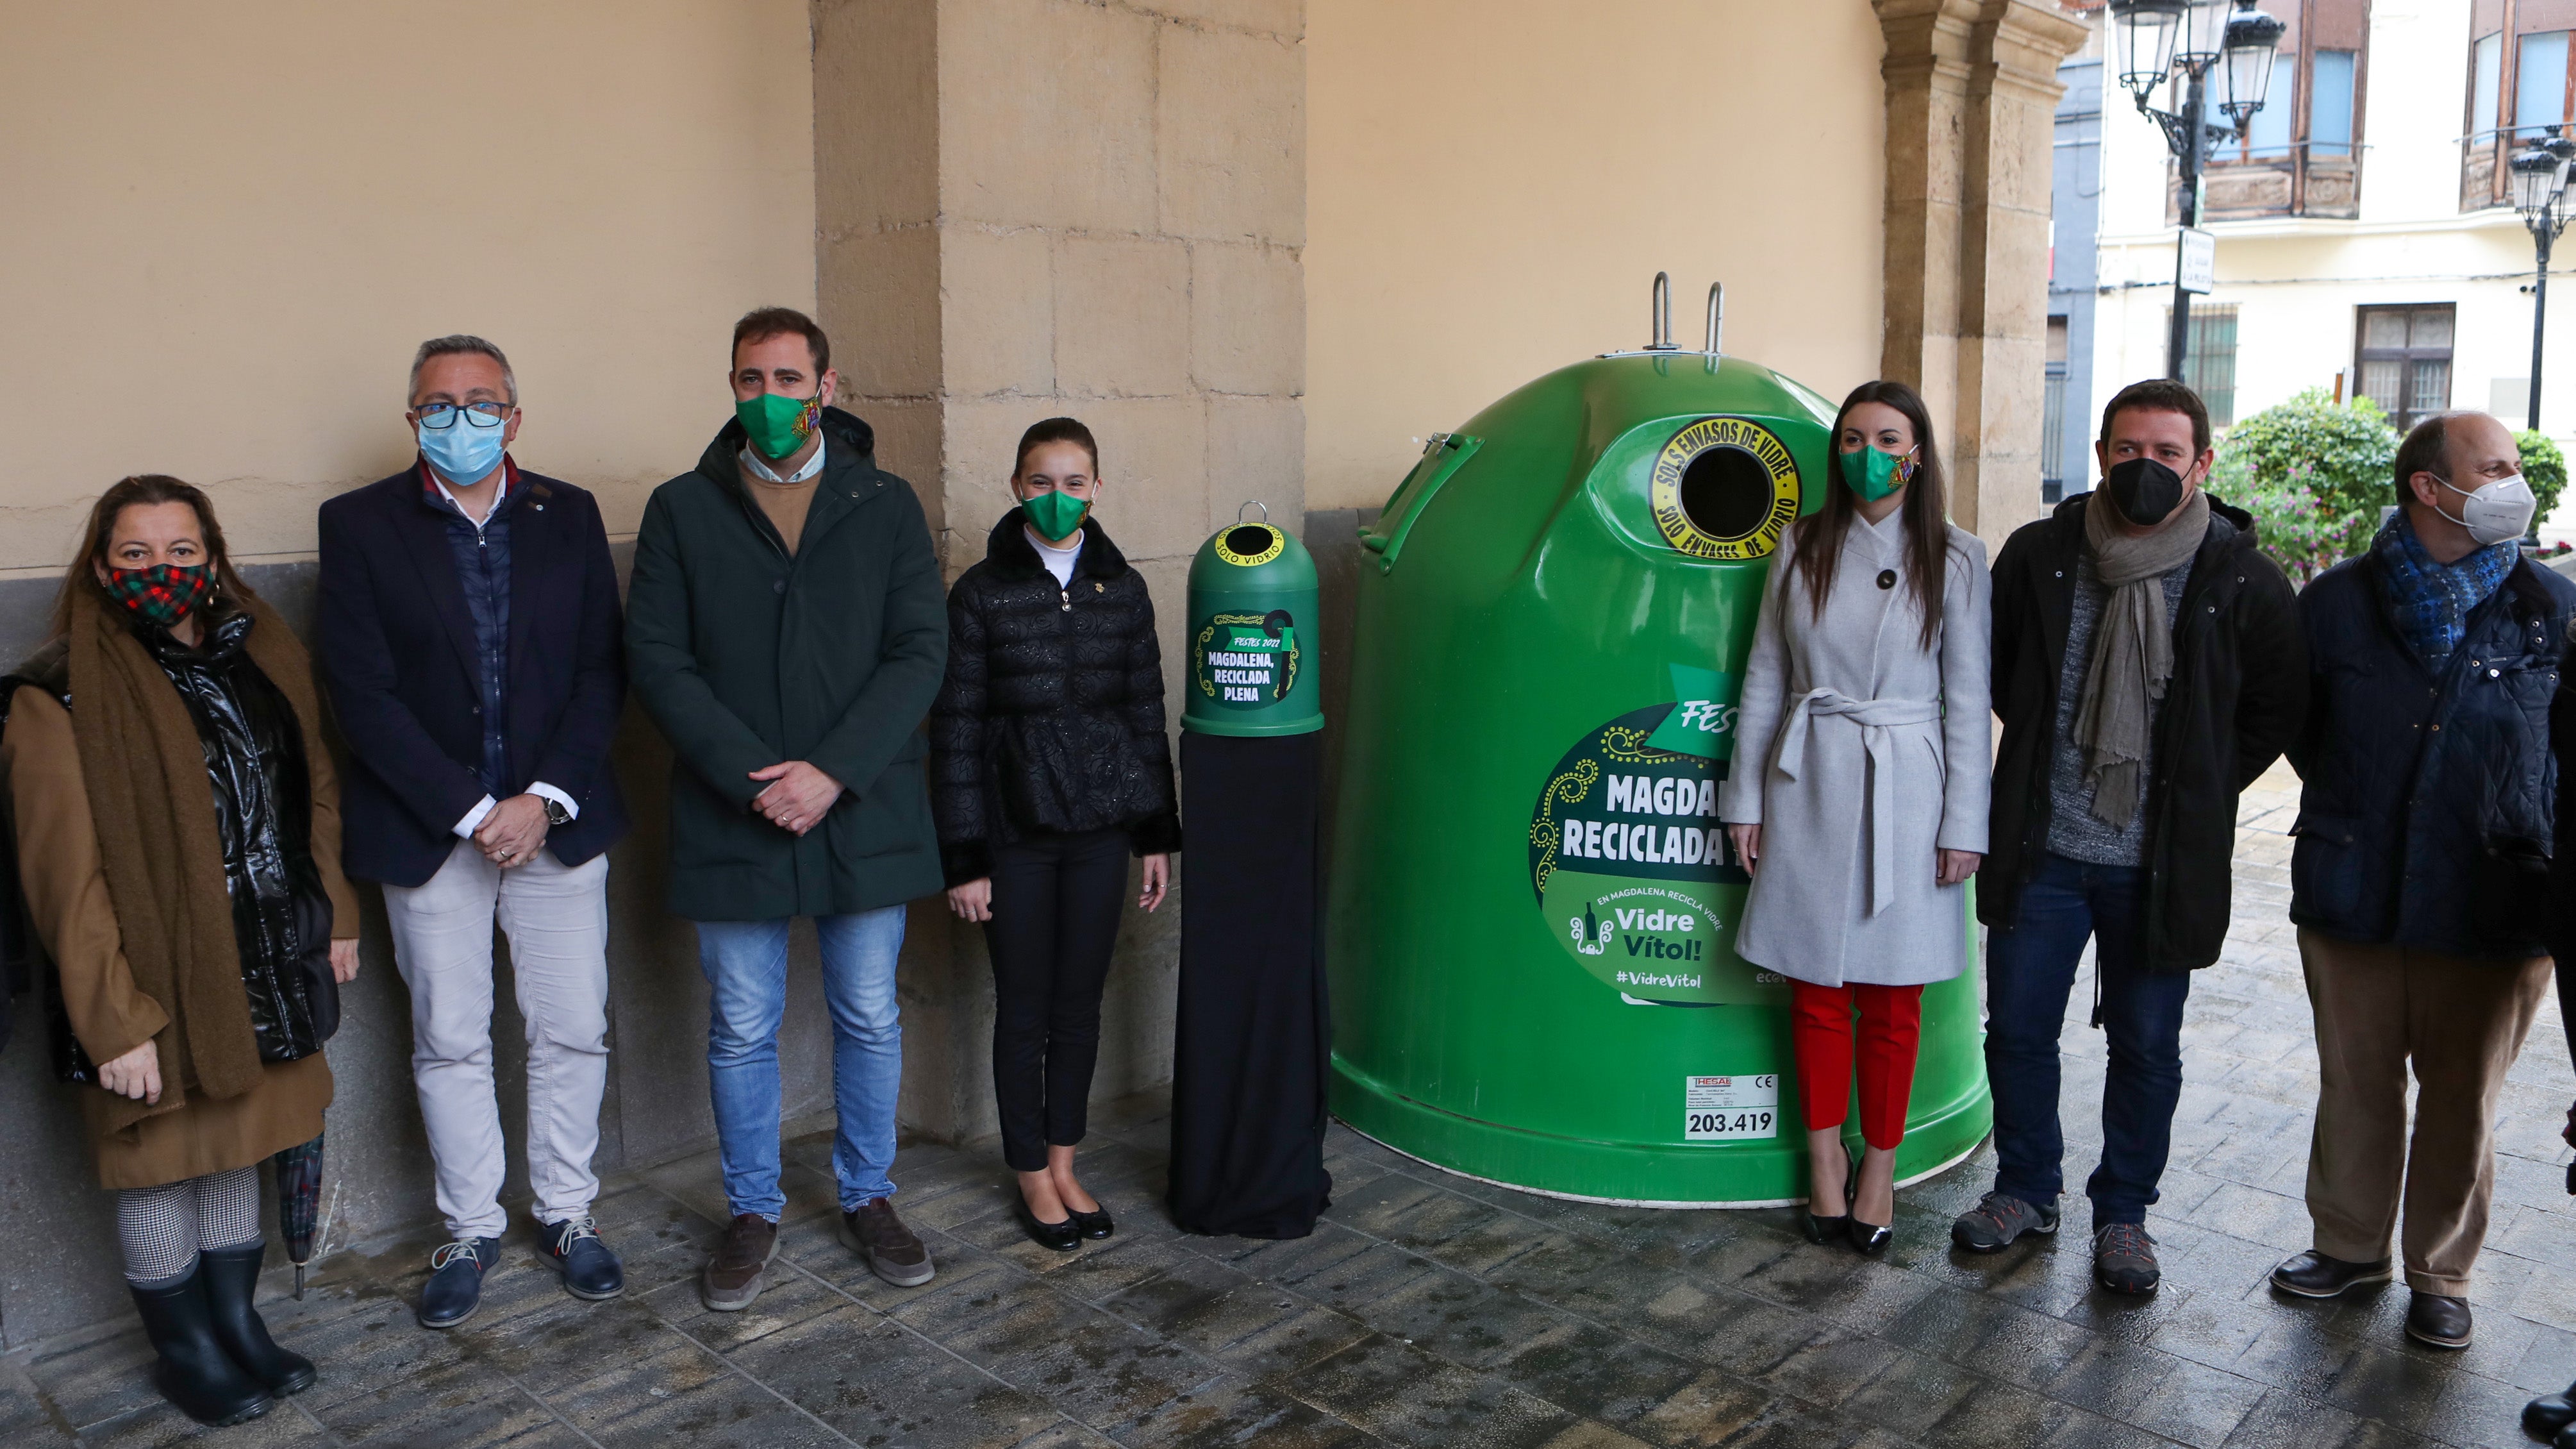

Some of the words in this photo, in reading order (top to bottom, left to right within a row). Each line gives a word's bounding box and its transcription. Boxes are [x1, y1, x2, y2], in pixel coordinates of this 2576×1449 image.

[1656, 448, 1686, 487] SOLS
[1675, 422, 1739, 456] ENVASOS
[1740, 426, 1761, 450] DE
[1757, 436, 1794, 481] VIDRE
[1657, 505, 1686, 539] SOLO
[1681, 533, 1740, 558] ENVASES
[1744, 537, 1765, 557] DE
[1761, 498, 1796, 544] VIDRIO
[1217, 544, 1239, 563] SOLO
[1244, 548, 1280, 564] VIDRIO
[1234, 637, 1261, 648] FESTES
[1261, 638, 1281, 648] 2022
[1208, 651, 1274, 669] MAGDALENA,
[1214, 669, 1271, 685] RECICLADA
[1224, 686, 1259, 702] PLENA
[1563, 818, 1724, 866] RECICLADA
[1597, 895, 1610, 906] EN
[1609, 887, 1666, 901] MAGDALENA
[1667, 890, 1704, 912] RECICLA
[1703, 907, 1723, 932] VIDRE
[1615, 908, 1695, 932] Vidre
[1624, 934, 1702, 961] Vítol!
[1689, 1112, 1772, 1133] 203.419
